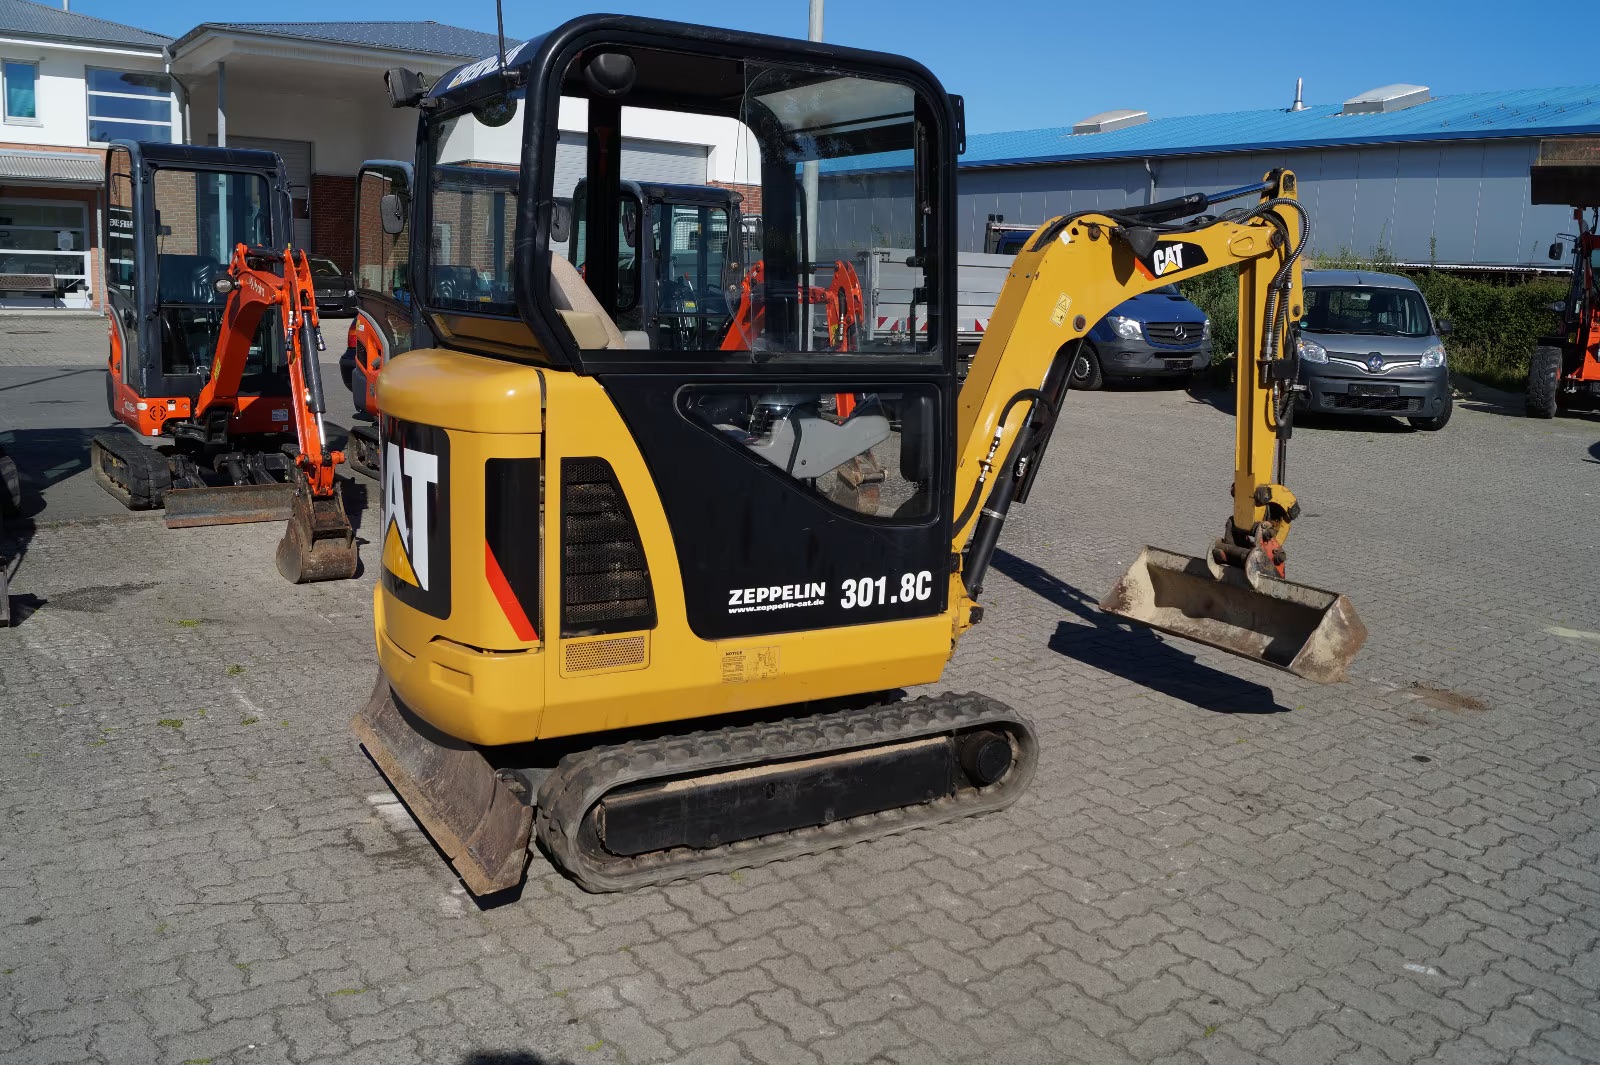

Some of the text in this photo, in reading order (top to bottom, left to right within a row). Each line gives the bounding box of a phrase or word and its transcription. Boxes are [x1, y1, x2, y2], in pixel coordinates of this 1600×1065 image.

[1153, 243, 1183, 276] CAT
[384, 441, 438, 592] AT
[728, 570, 932, 609] ZEPPELIN 301.8C
[728, 599, 825, 614] www.zeppelin-cat.de
